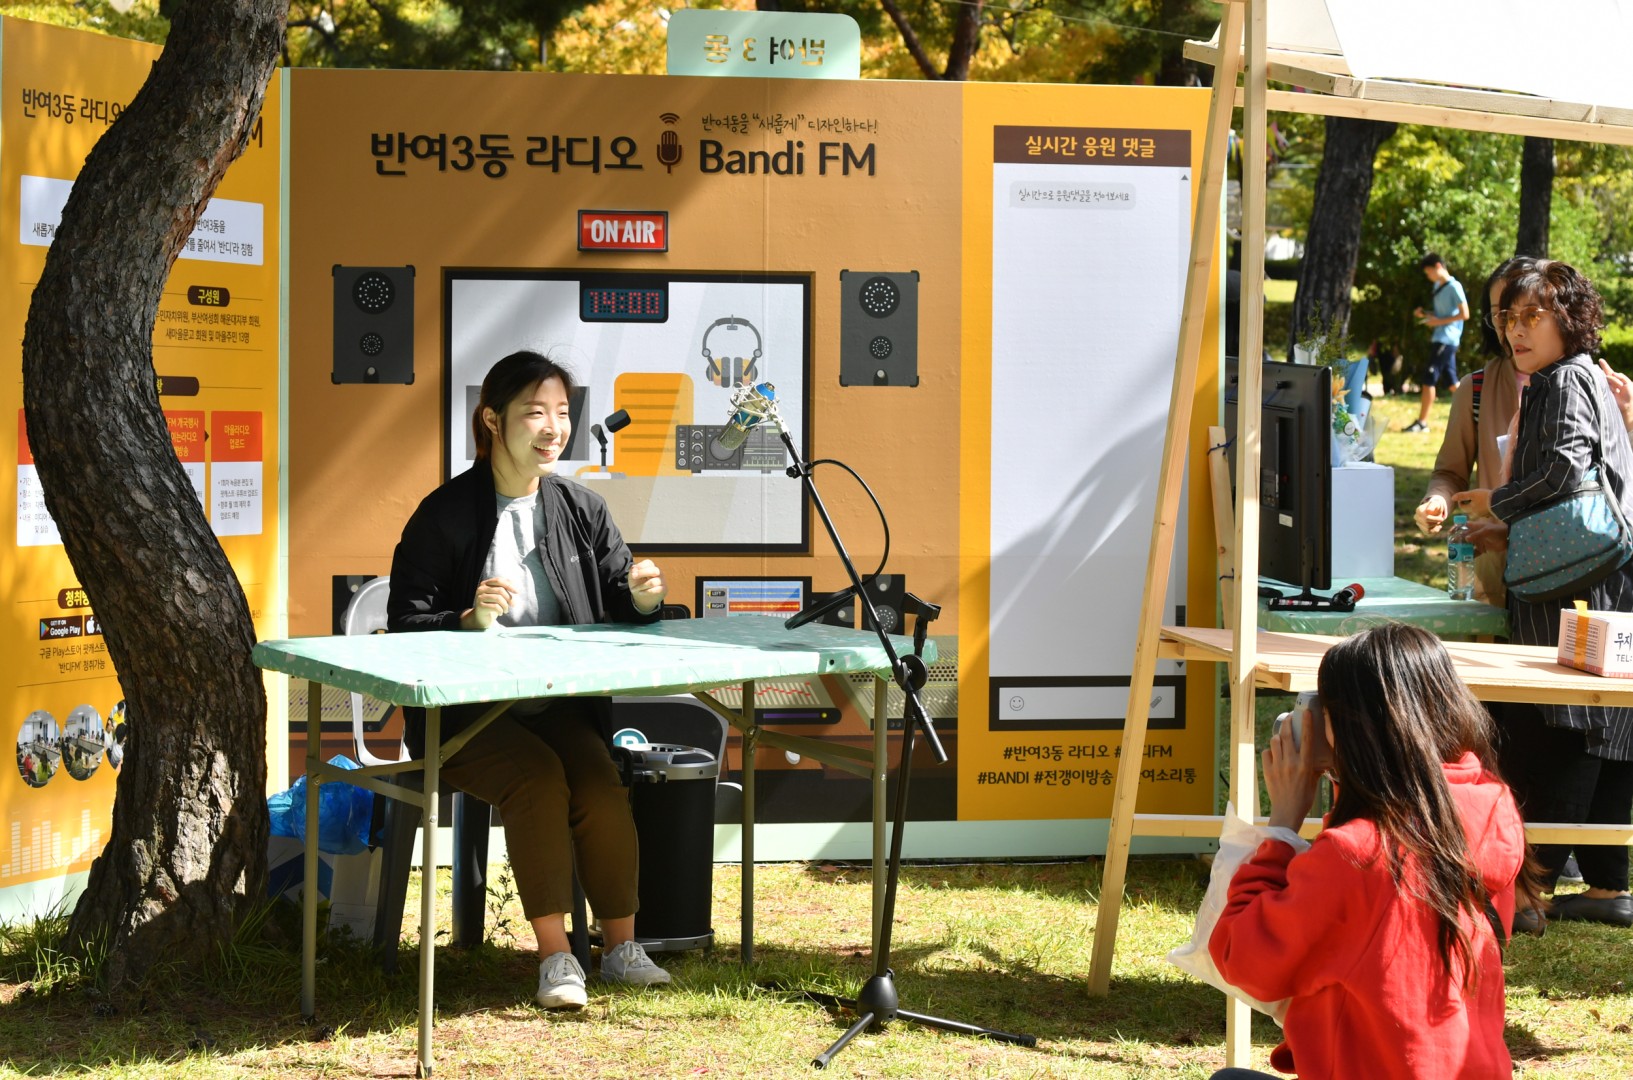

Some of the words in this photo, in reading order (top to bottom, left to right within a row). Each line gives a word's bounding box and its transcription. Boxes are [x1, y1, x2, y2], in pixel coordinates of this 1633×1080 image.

[22, 88, 77, 124] 반여3동
[701, 113, 750, 134] 반여동을
[808, 117, 878, 134] 디자인하다!
[371, 132, 514, 178] 반여3동
[526, 135, 643, 173] 라디오
[1025, 135, 1078, 156] 실시간
[1082, 136, 1116, 157] 응원
[1122, 137, 1156, 158] 댓글
[700, 139, 804, 175] Bandi
[818, 142, 875, 176] FM
[1018, 188, 1055, 201] 실시간으로
[591, 219, 619, 243] ON
[622, 220, 656, 244] AIR
[197, 289, 220, 305] 구성원
[590, 291, 659, 314] 14:00
[166, 417, 177, 428] FM
[50, 627, 69, 637] Google
[69, 625, 81, 635] Play
[40, 647, 52, 659] 구글
[1003, 745, 1065, 762] #반여3동
[1068, 745, 1110, 759] 라디오
[977, 771, 1030, 785] #BANDI
[1034, 769, 1114, 786] #전갱이방송
[1139, 768, 1197, 785] 여소리통
